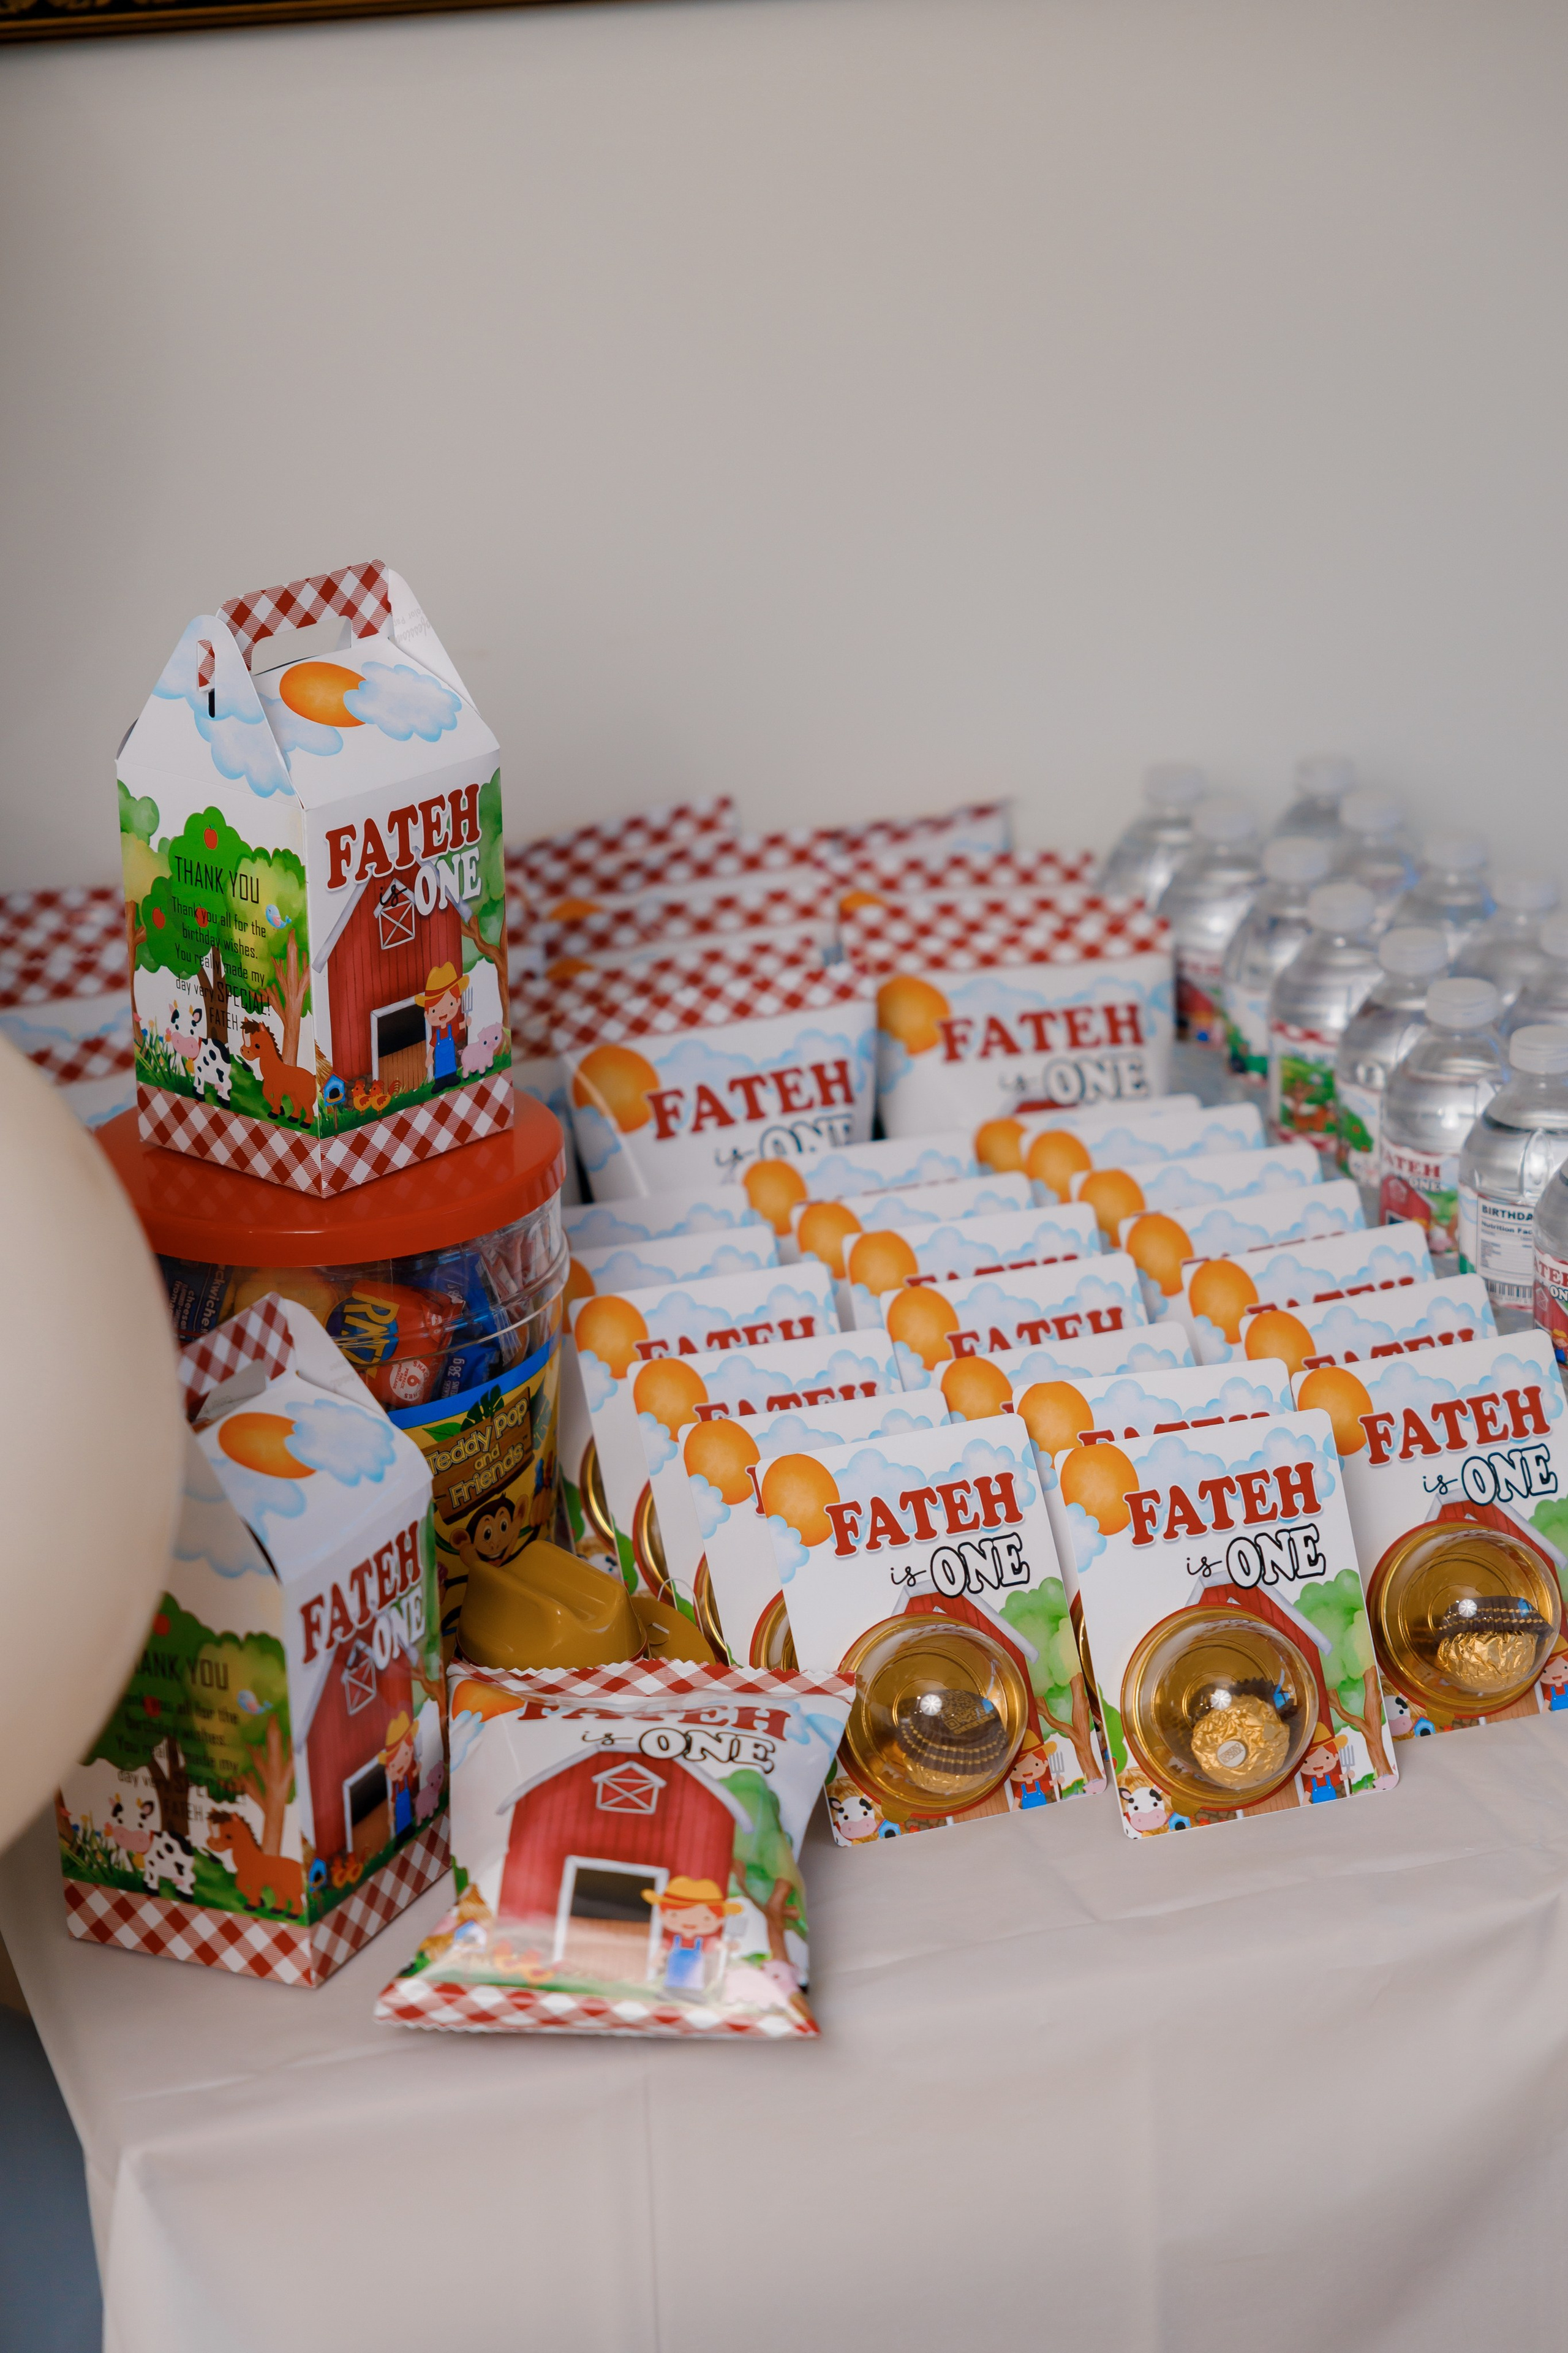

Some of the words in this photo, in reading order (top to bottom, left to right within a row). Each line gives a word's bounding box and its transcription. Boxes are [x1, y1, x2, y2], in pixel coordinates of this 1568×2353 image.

[325, 782, 481, 890] FATEH
[175, 855, 224, 894] THANK
[228, 870, 259, 904] YOU
[380, 884, 408, 907] is
[415, 846, 481, 916] ONE
[172, 896, 198, 919] Thank
[202, 910, 217, 924] you
[221, 912, 232, 928] all
[234, 914, 248, 932] for
[251, 920, 266, 938] the
[182, 921, 221, 951] birthday
[223, 938, 258, 959] wishes.
[175, 942, 191, 962] You
[195, 953, 221, 973] really
[224, 962, 248, 979] made
[251, 971, 265, 987] my
[176, 973, 190, 995] day
[194, 984, 214, 1002] very
[217, 981, 271, 1016] SPECIAL!
[209, 1007, 238, 1031] FATEH
[939, 1003, 1144, 1065] FATEH
[647, 1059, 854, 1141] FATEH
[1042, 1051, 1149, 1105] ONE
[1385, 1150, 1441, 1177] ATEH
[1482, 1204, 1534, 1221] BIRTHDA
[1550, 1285, 1568, 1302] ON
[448, 1365, 462, 1378] 38
[425, 1426, 492, 1476] Teddy
[493, 1397, 529, 1440] pop
[1358, 1386, 1551, 1465] FATEH
[448, 1442, 524, 1509] Friends
[473, 1442, 501, 1471] and
[1422, 1474, 1458, 1495] is
[1461, 1443, 1558, 1506] ONE
[825, 1471, 1023, 1557] FATEH
[1123, 1461, 1322, 1546] FATEH
[890, 1566, 927, 1587] is
[930, 1532, 1030, 1599] ONE
[1186, 1556, 1223, 1578] is
[1226, 1522, 1327, 1590] ONE
[300, 1520, 421, 1664] FATEH
[372, 1585, 426, 1671] ONE
[186, 1656, 229, 1692] YOU
[518, 1701, 791, 1742] FAEH
[581, 1730, 634, 1745] is
[639, 1727, 776, 1775] ONE
